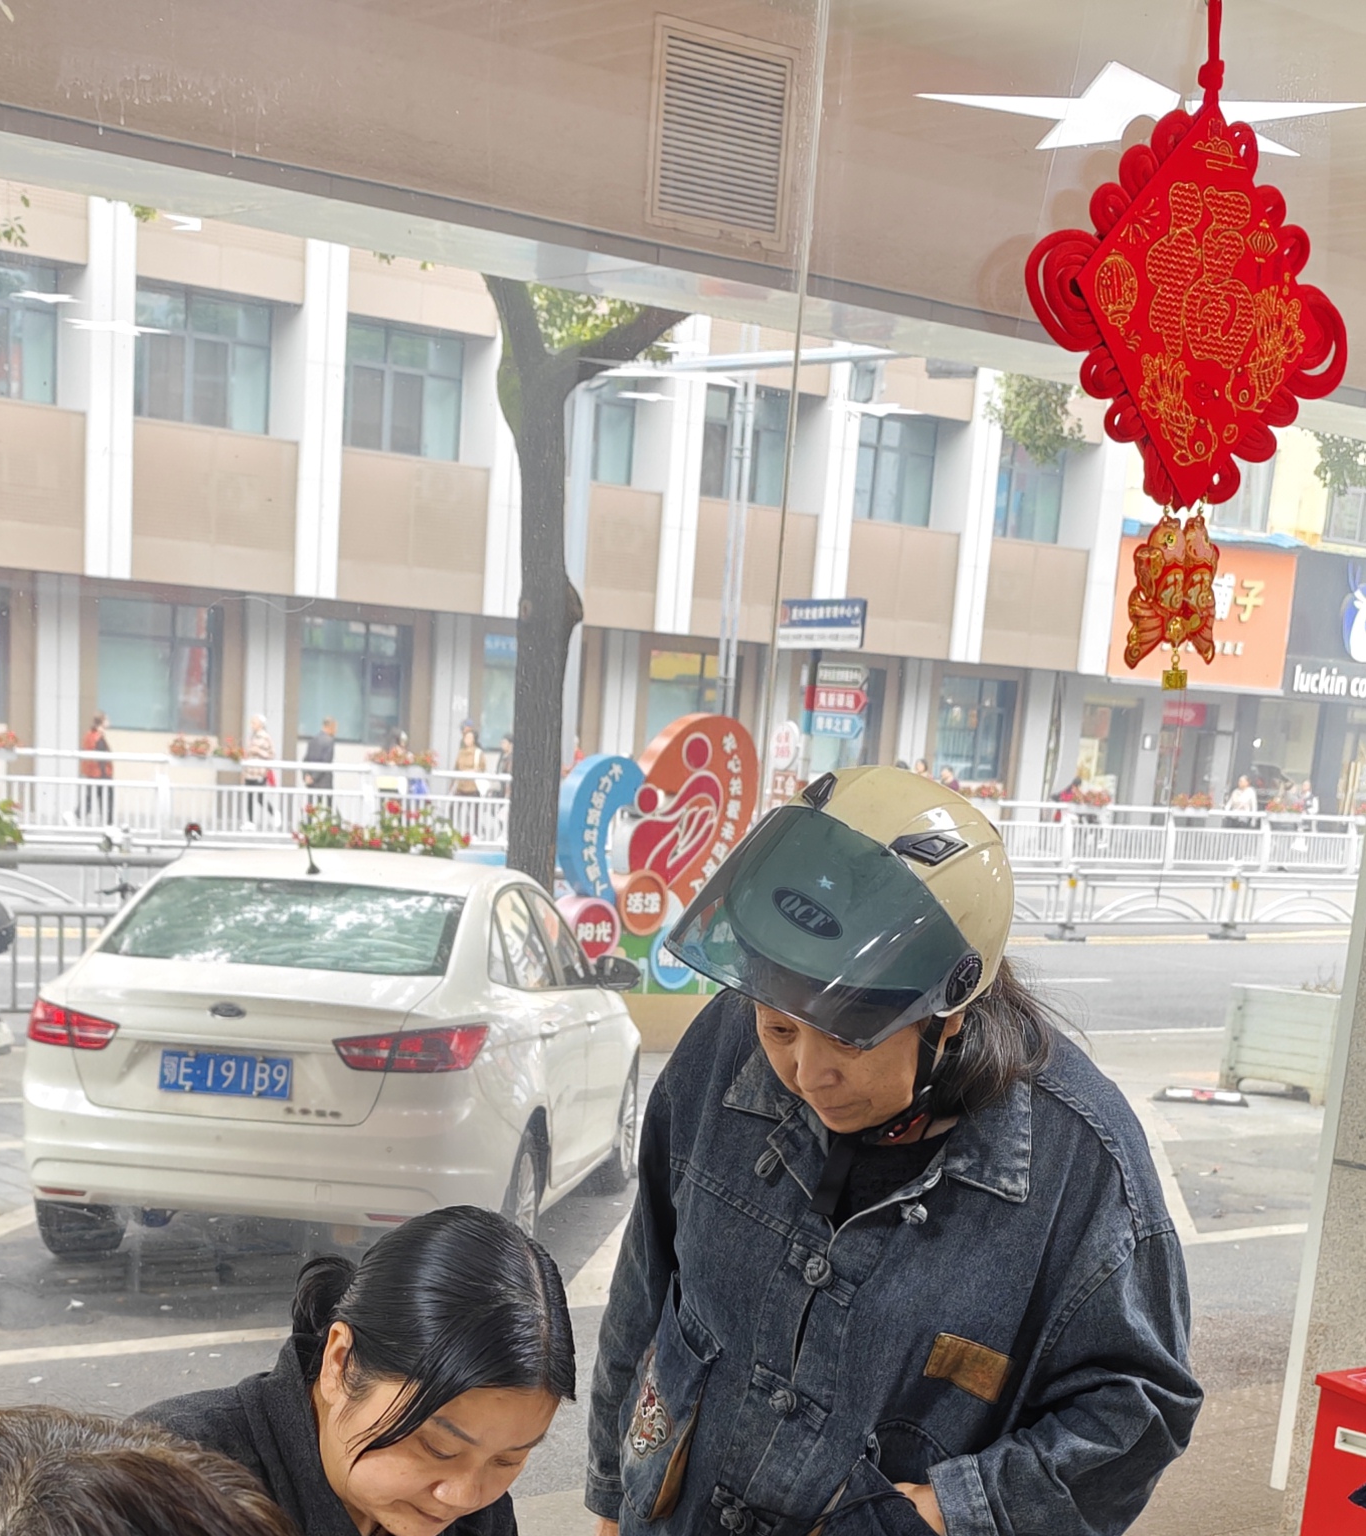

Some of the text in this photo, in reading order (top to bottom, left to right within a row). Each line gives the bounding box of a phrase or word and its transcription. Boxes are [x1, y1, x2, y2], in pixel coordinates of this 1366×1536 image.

[1145, 181, 1255, 368] 福
[1293, 664, 1346, 697] luckin
[626, 891, 661, 914] 活泼
[577, 921, 612, 942] 阳光
